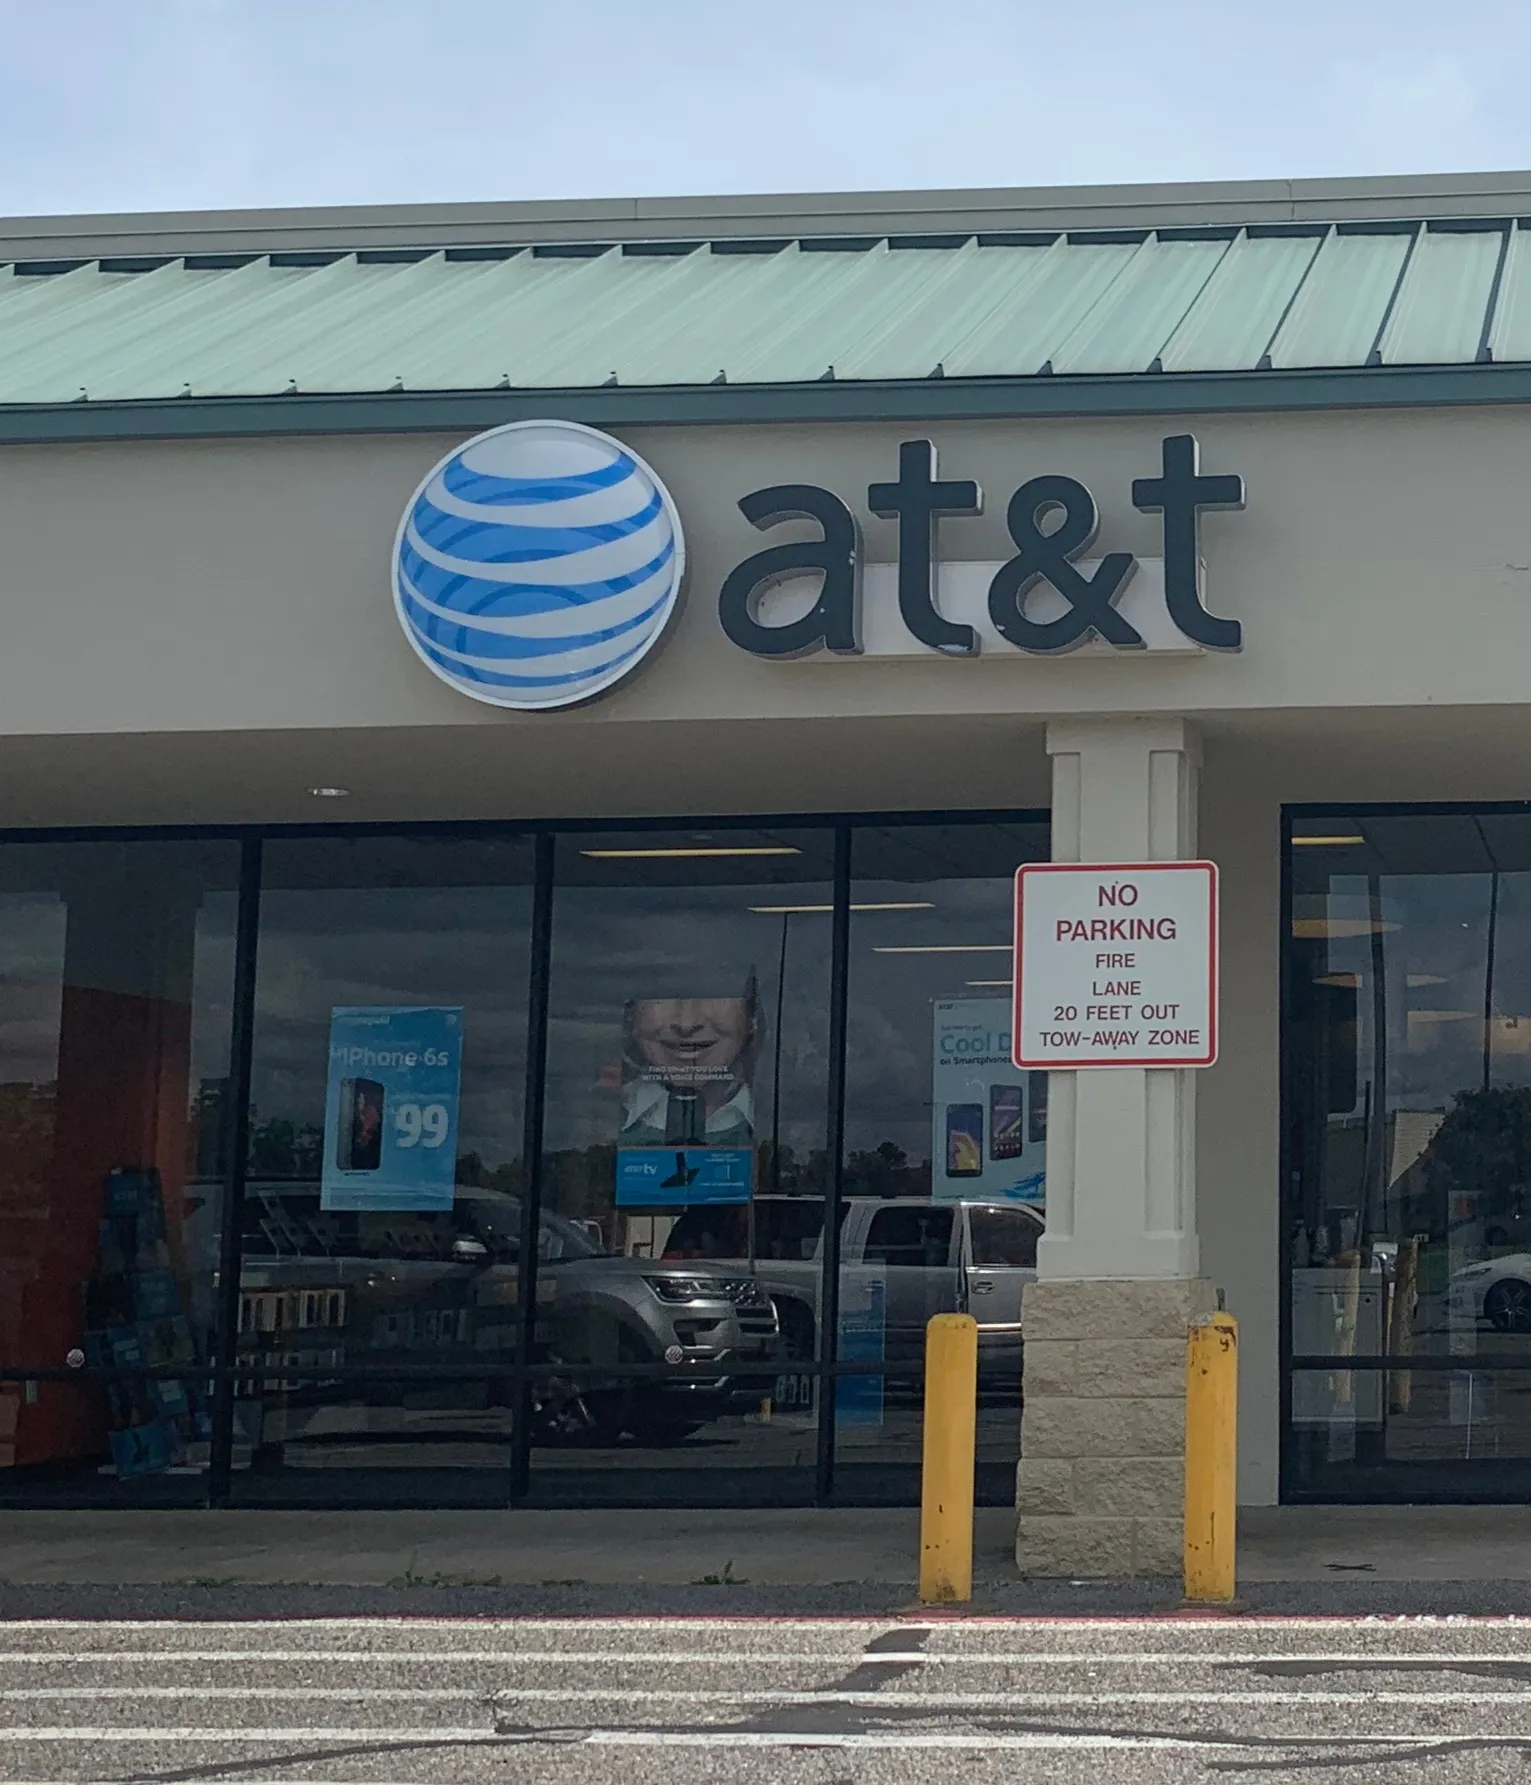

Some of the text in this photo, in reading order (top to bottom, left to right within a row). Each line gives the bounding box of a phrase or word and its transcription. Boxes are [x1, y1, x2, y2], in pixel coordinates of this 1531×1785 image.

[718, 433, 1246, 658] at&t
[1098, 884, 1138, 907] NO
[1056, 918, 1177, 942] PARKING
[1095, 953, 1136, 968] FIRE
[1092, 981, 1141, 996] LANE
[1053, 1004, 1180, 1021] 20 FEET OUT
[940, 1032, 991, 1053] Cool
[1039, 1029, 1200, 1047] TOW-AWAY ZONE
[424, 1047, 449, 1067] 6s
[396, 1103, 449, 1148] 99
